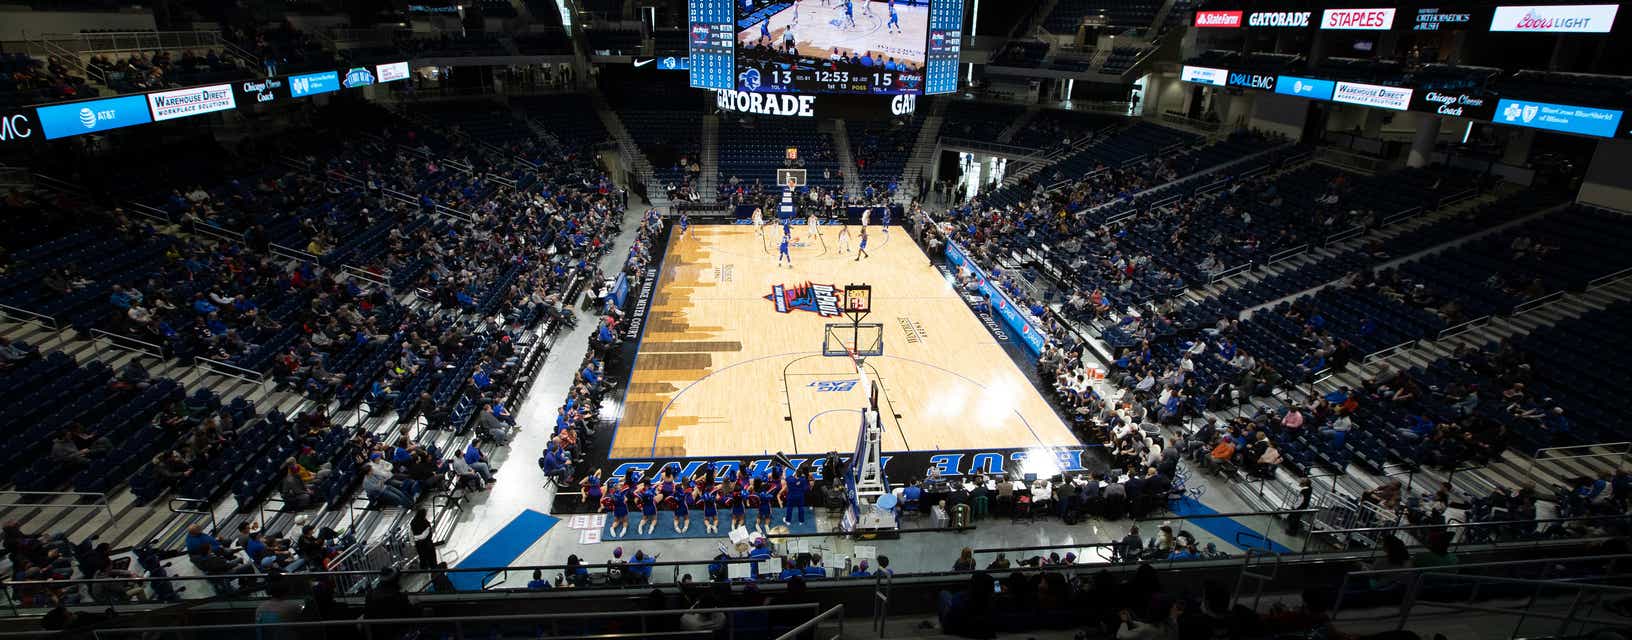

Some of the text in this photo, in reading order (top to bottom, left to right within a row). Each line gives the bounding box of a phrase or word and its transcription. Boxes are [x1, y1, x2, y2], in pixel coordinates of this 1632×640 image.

[1249, 12, 1311, 27] GATORADE
[1330, 12, 1385, 27] STAPLES
[1517, 13, 1591, 29] Coors LIGHT
[772, 71, 792, 84] 13
[815, 71, 848, 82] 12:53
[873, 73, 892, 86] 15
[155, 90, 226, 107] WAREHOUSE DIRECT
[1340, 84, 1404, 99] WAREHOUSE DIRECT
[1426, 92, 1456, 105] Chicago
[158, 100, 229, 116] WORKPLACE SOLUTIONS
[717, 89, 814, 116] GATORADE
[97, 110, 116, 120] AT&T
[1437, 105, 1463, 116] Coach
[633, 299, 647, 317] MEYER
[626, 317, 642, 338] COURT
